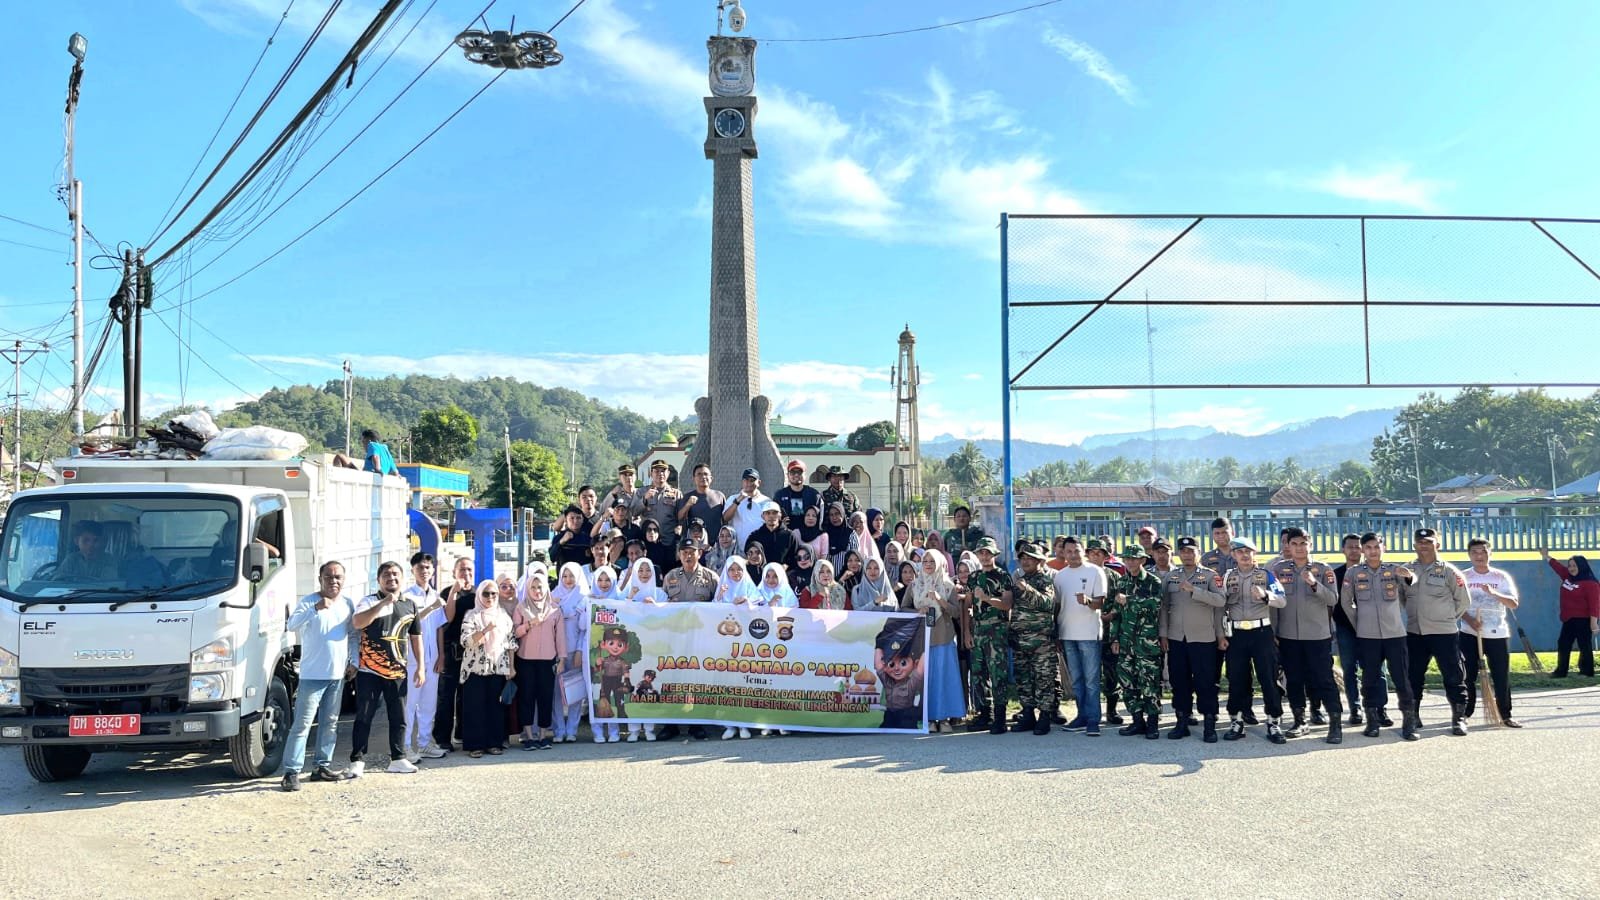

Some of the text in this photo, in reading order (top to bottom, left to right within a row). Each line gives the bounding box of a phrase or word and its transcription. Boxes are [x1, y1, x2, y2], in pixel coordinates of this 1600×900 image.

[596, 612, 616, 624] 110
[23, 621, 57, 630] ELF
[73, 649, 134, 661] ISUZU
[731, 642, 788, 659] JAGO
[656, 655, 701, 673] JAGA
[702, 657, 806, 677] GORONTALO
[743, 674, 768, 685] Tema
[660, 682, 727, 695] KEBERSIHAN
[728, 685, 779, 698] SEBAGIAN
[780, 688, 805, 700] DARI
[630, 692, 871, 713] MARI BERSIHKAN HATI BERSIHKAN LINGKUNGAN
[73, 716, 137, 729] DM 8840 P
